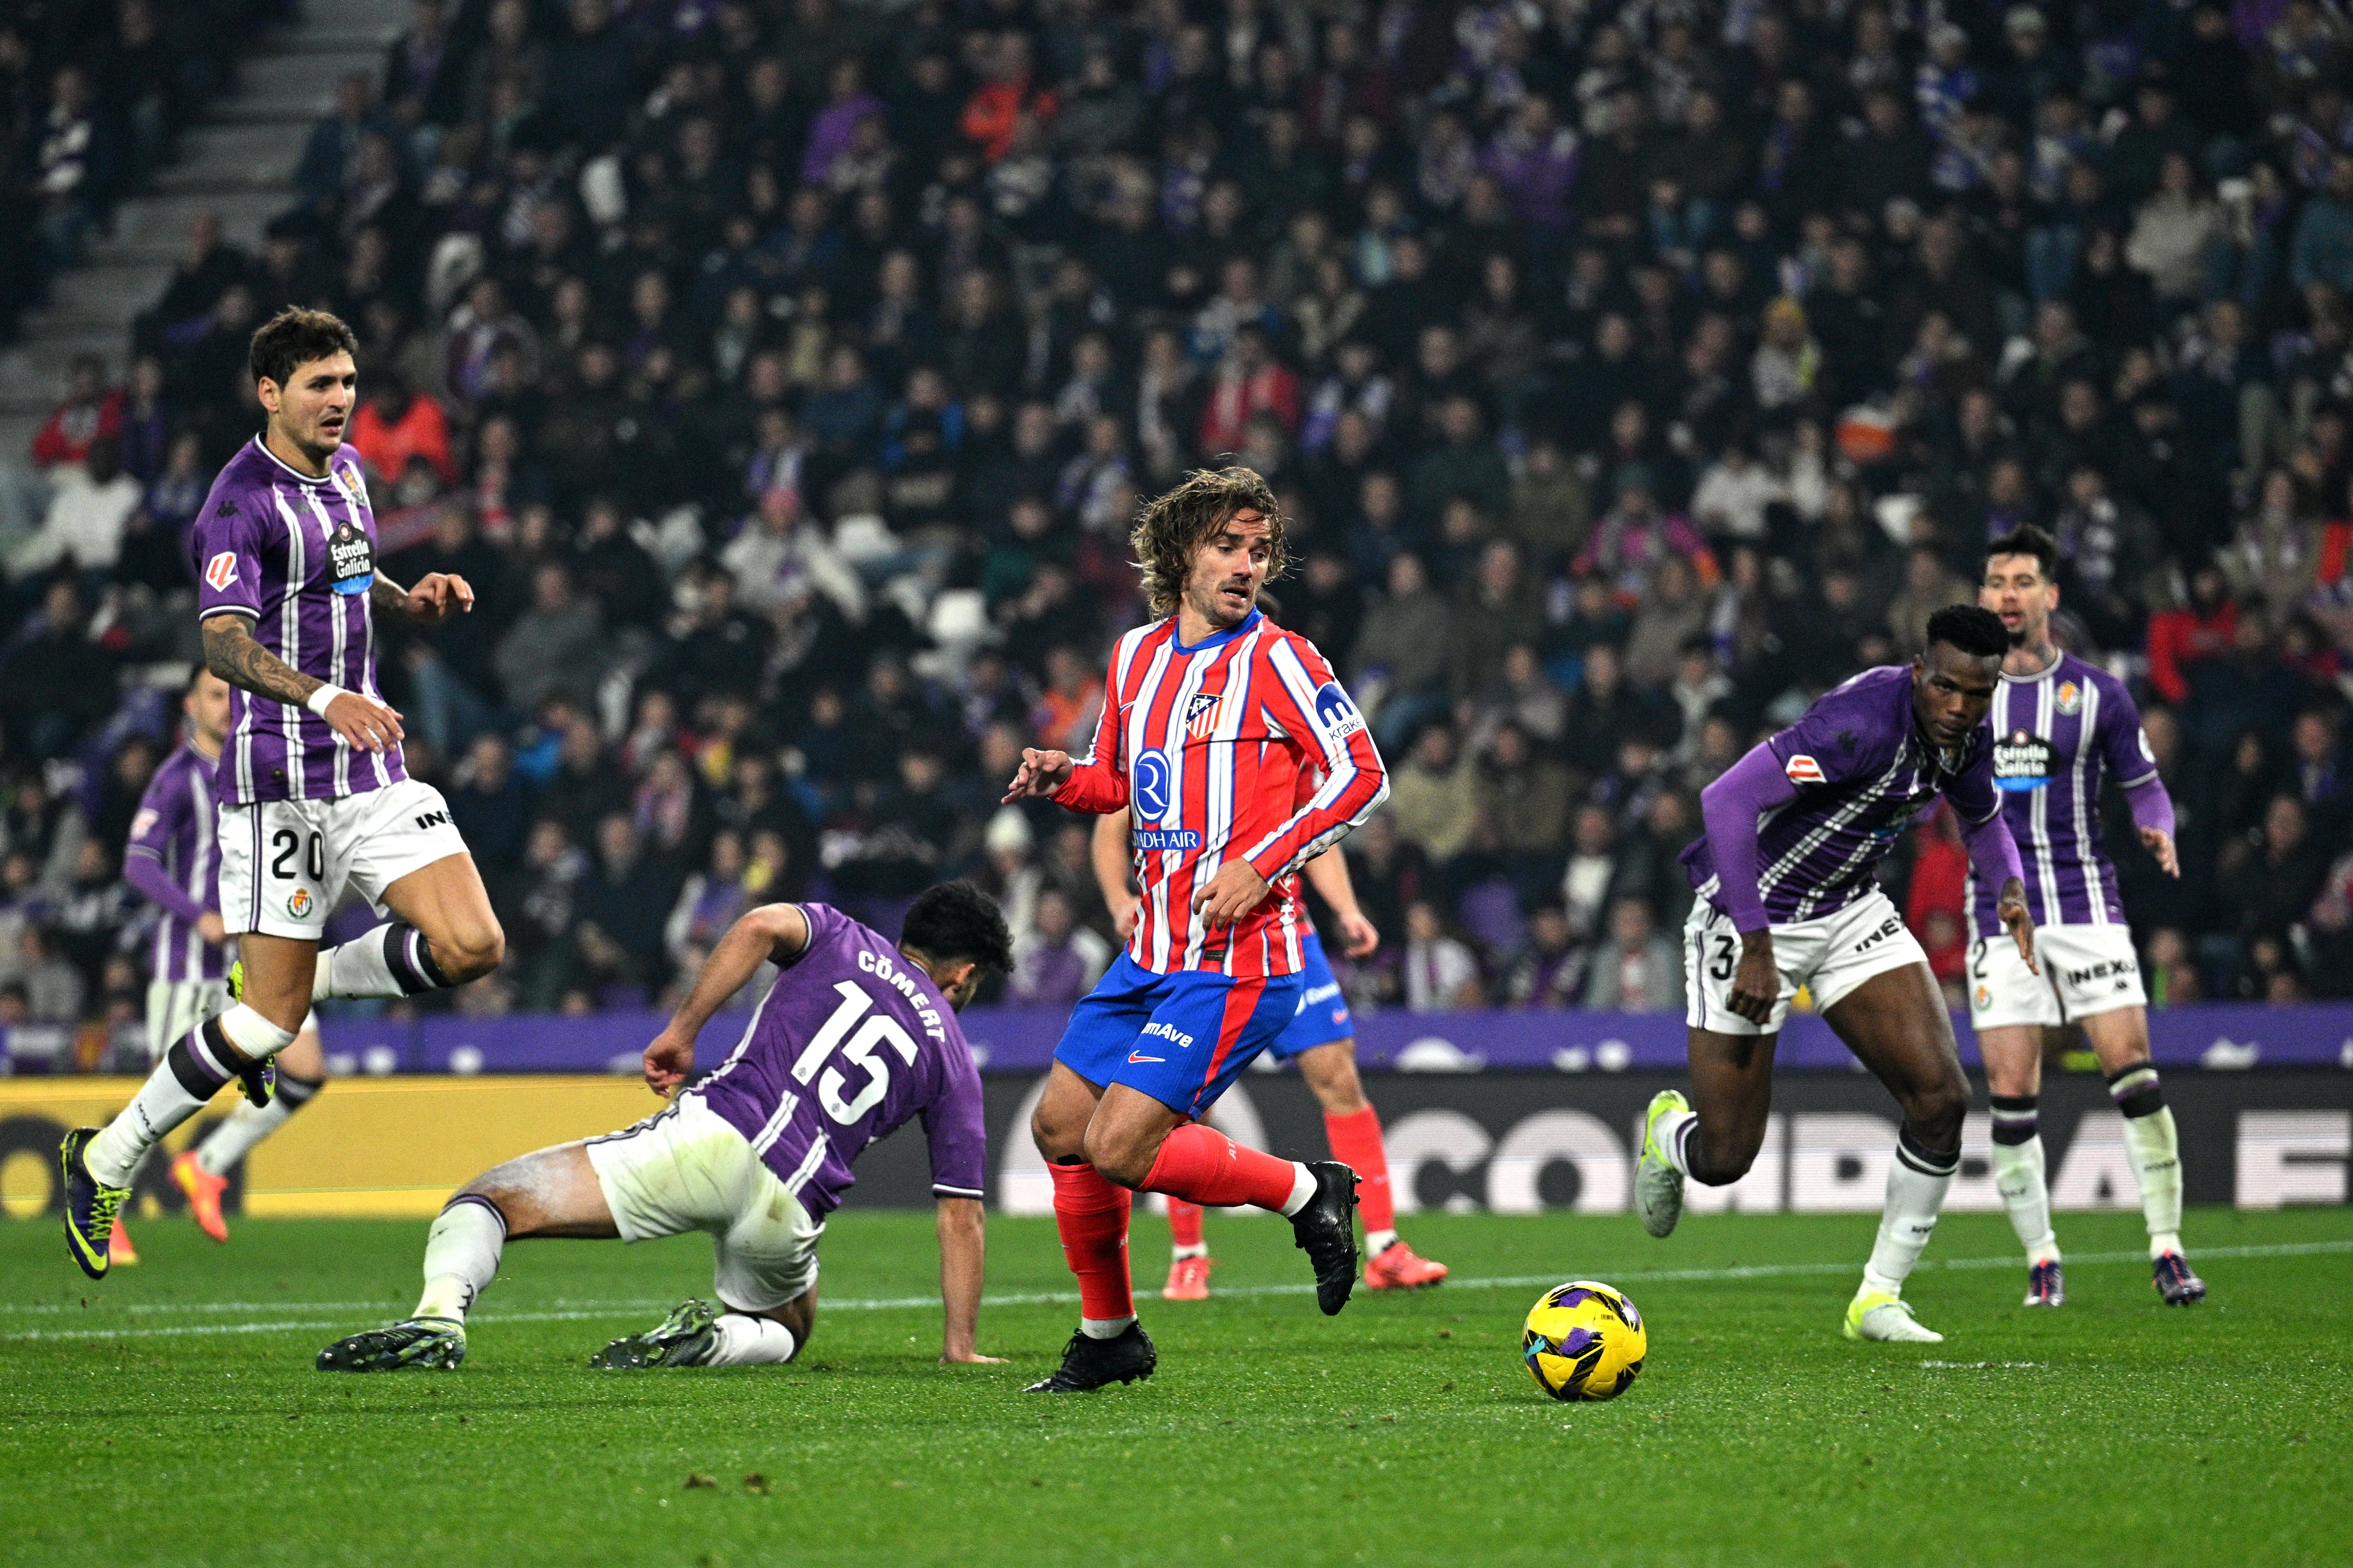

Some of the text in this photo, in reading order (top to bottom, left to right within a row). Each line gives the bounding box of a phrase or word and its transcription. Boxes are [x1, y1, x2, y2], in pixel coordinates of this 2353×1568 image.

[331, 539, 369, 561] Estrella
[336, 556, 370, 578] Galicia
[272, 829, 324, 881] 20
[1169, 832, 1197, 847] AIR
[1711, 935, 1734, 980] 3
[1974, 936, 1988, 978] 2
[858, 950, 945, 1043] CÖMERT
[791, 980, 919, 1126] 15
